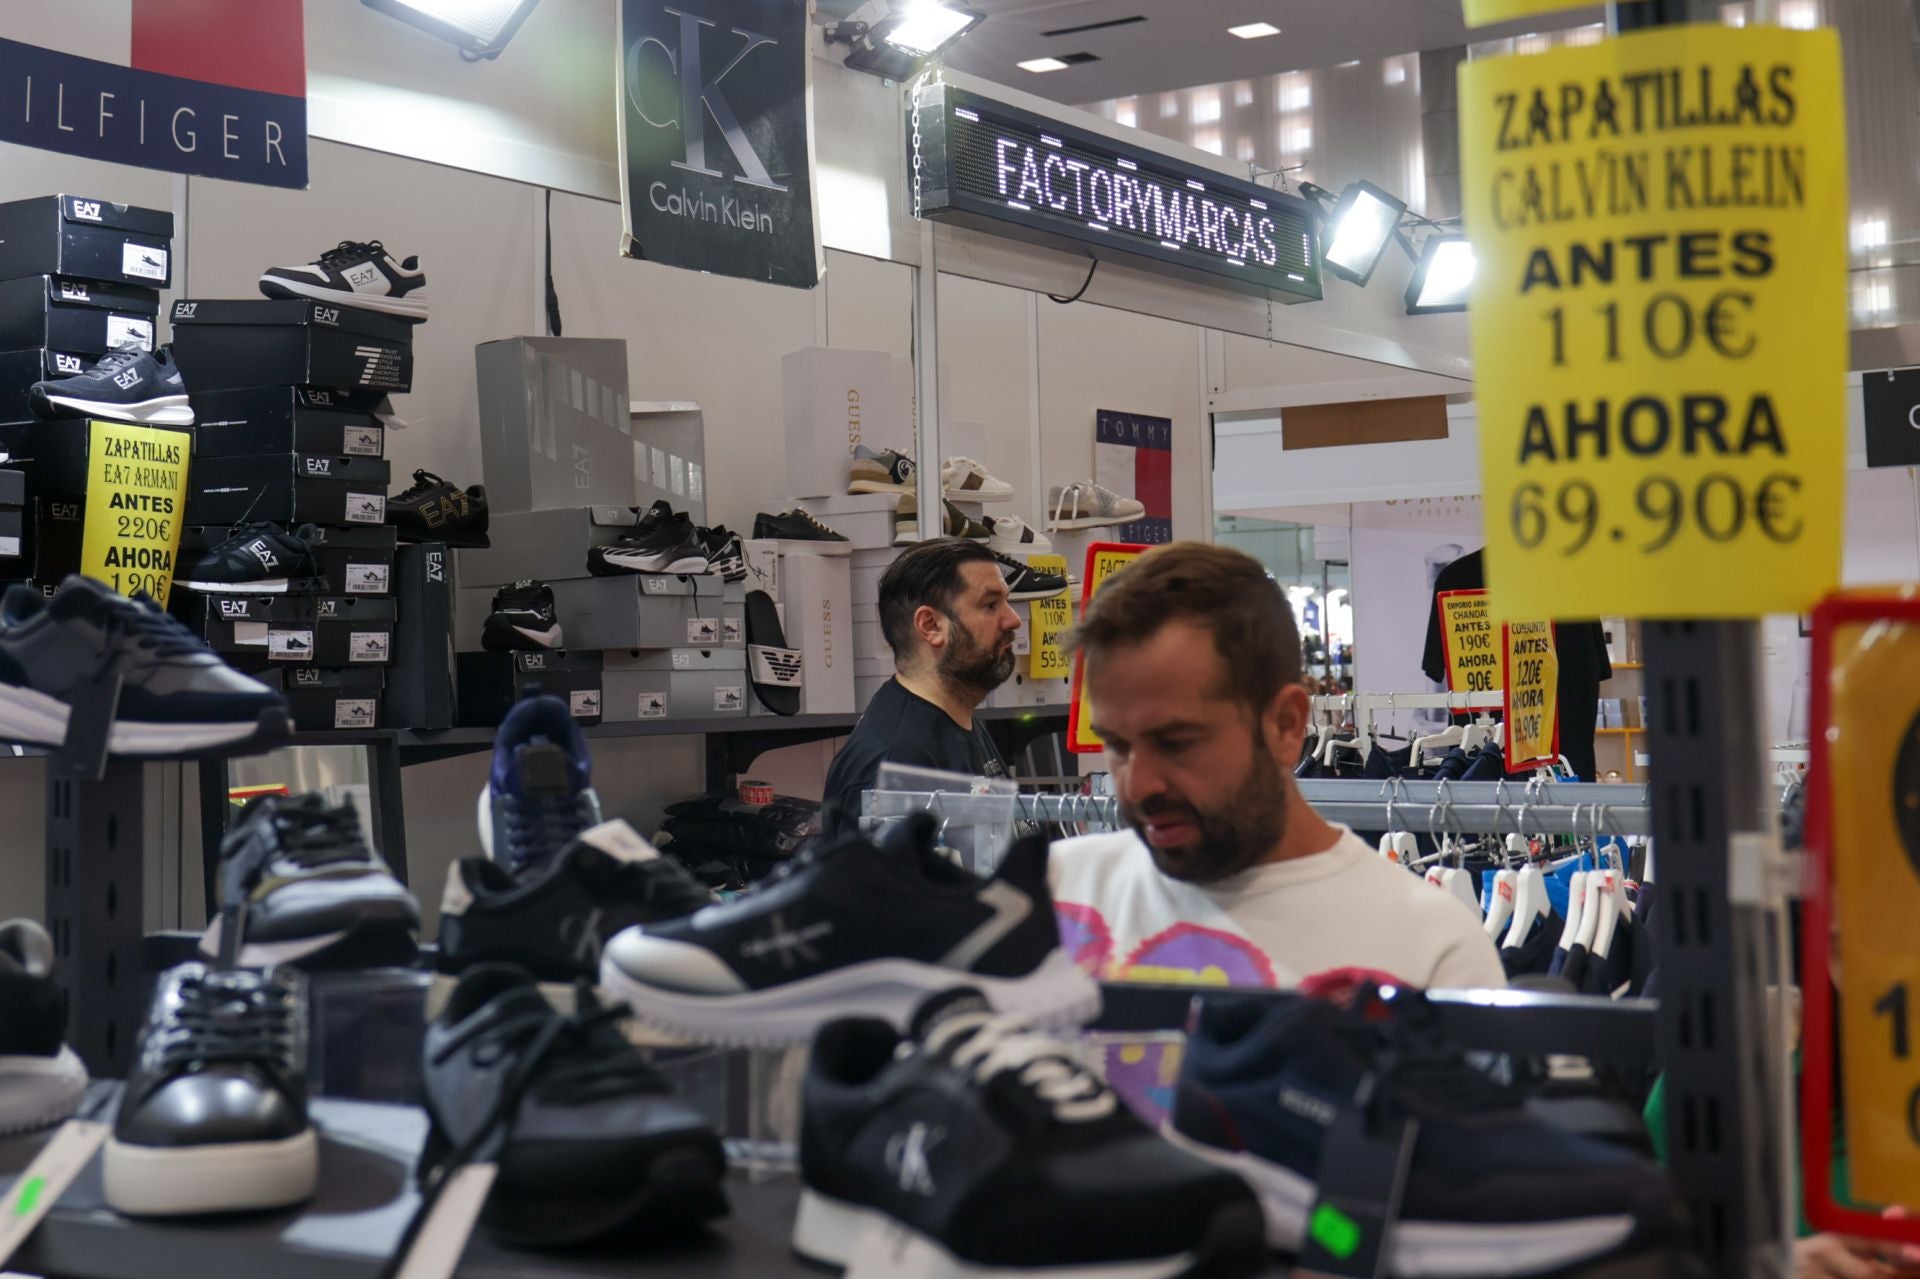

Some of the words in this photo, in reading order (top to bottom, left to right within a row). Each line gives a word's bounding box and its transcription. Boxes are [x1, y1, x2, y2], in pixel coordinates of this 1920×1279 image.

[1493, 63, 1797, 152] ZAPATILLAS
[25, 75, 287, 166] ILFIGER
[1490, 147, 1650, 232] CALVIN
[1664, 144, 1806, 212] KLEIN
[73, 200, 100, 217] EA7
[649, 180, 718, 223] Calvin
[721, 194, 773, 234] Klein
[997, 138, 1276, 266] FACTORYMARCAS
[1520, 231, 1776, 293] ANTES
[349, 269, 374, 285] EA7
[61, 282, 89, 297] EA7
[175, 303, 198, 315] EA7
[314, 306, 339, 322] EA7
[1545, 291, 1758, 368] 110€
[56, 354, 81, 370] EA7
[113, 367, 138, 387] EA7
[1101, 418, 1168, 441] TOMMY
[1519, 393, 1788, 464] AHORA
[104, 436, 180, 465] ZAPATILLAS
[306, 458, 330, 471] EA7
[104, 463, 131, 484] EA7
[134, 466, 179, 490] ARMANI
[52, 503, 79, 517] EA7
[109, 492, 174, 514] ANTES
[419, 489, 469, 529] EA7
[1510, 472, 1806, 558] 69.90€
[117, 515, 171, 542] 220€
[1120, 524, 1168, 544] LFIGER
[104, 546, 171, 571] AHORA
[249, 540, 279, 567] EA7
[430, 552, 443, 582] EA7
[1099, 558, 1132, 579] FACT
[110, 572, 167, 601] 120€
[221, 600, 248, 613] EA7
[1040, 599, 1067, 610] ANTES
[1044, 611, 1066, 626] 110€
[1455, 621, 1491, 632] ANTES
[823, 599, 833, 669] GUESS
[1459, 634, 1490, 651] 190€
[1513, 638, 1548, 655] ANTES
[525, 655, 543, 666] EA7
[1458, 654, 1497, 669] AHORA
[296, 669, 320, 681] EA7
[1467, 670, 1493, 692] 90€
[1516, 659, 1543, 687] 120€
